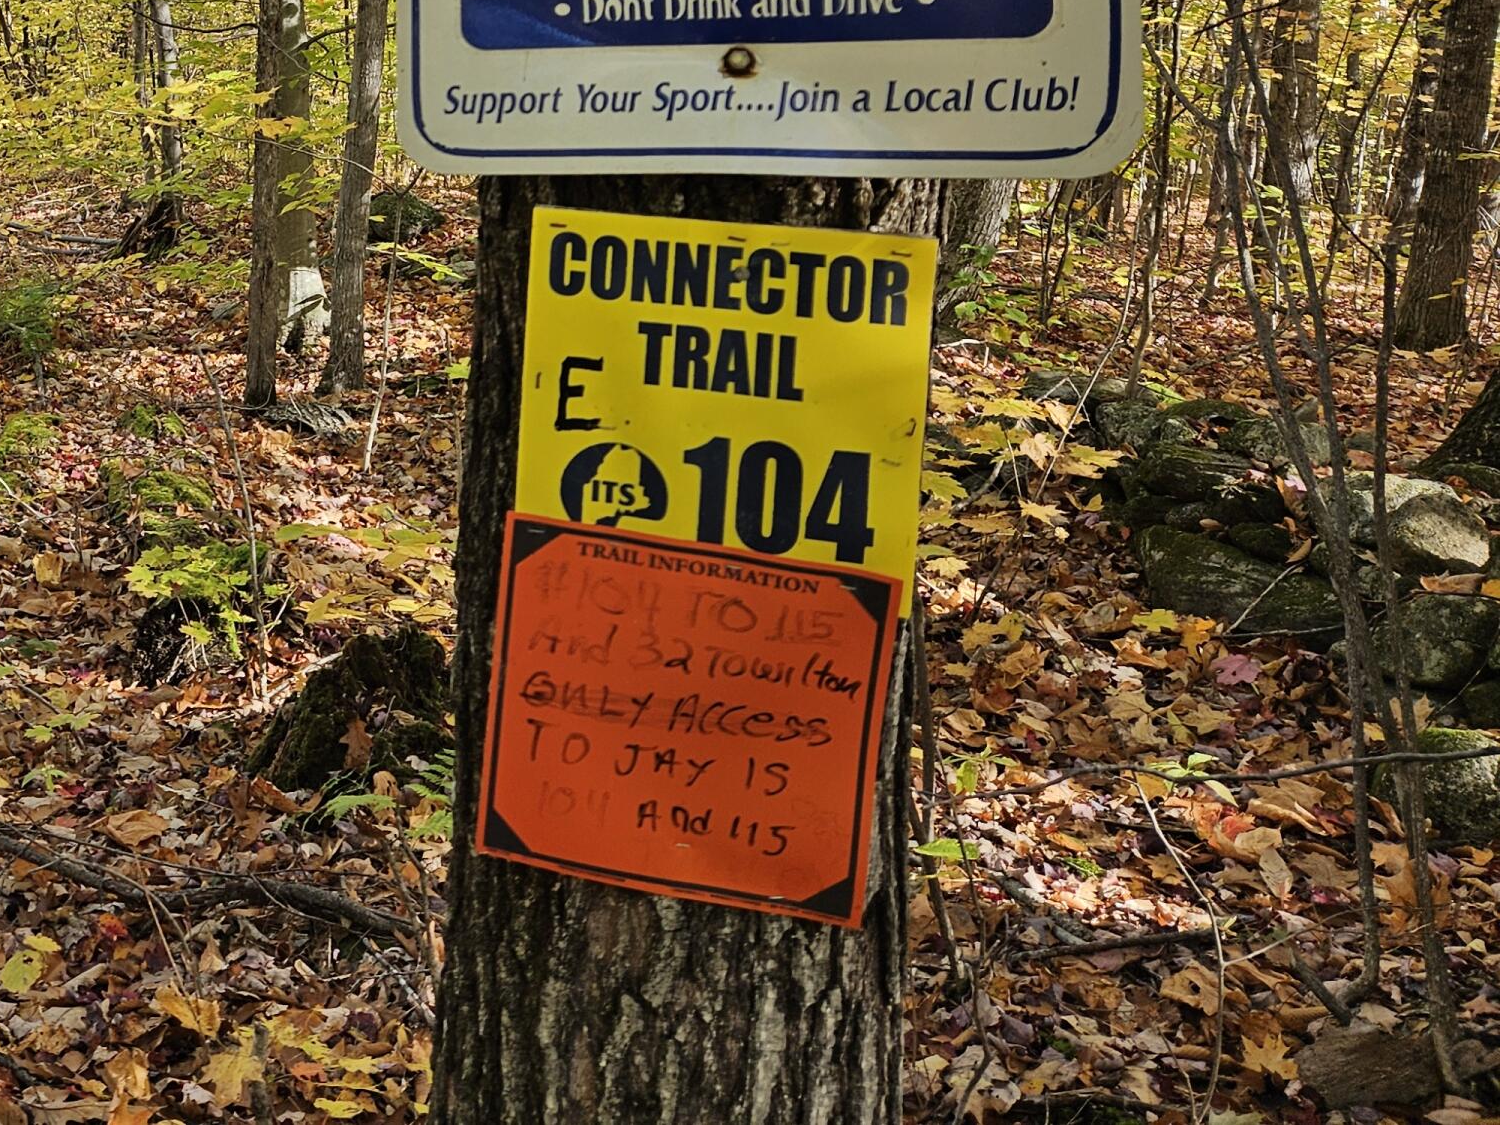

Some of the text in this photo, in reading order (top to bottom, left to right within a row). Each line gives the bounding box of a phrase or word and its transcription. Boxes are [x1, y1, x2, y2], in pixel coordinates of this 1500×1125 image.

[443, 85, 563, 124] Support
[575, 82, 642, 115] Your
[851, 89, 871, 112] a
[885, 80, 973, 112] Local
[984, 77, 1081, 112] Club!
[549, 232, 910, 326] CONNECTOR
[554, 356, 604, 431] E
[638, 321, 804, 402] TRAIL
[591, 436, 875, 565] ITS 104
[577, 541, 821, 594] TRAIL INFORMATION
[689, 586, 758, 632] TO
[765, 603, 844, 643] 115
[526, 718, 591, 765] TO
[614, 743, 716, 787] JAY
[730, 816, 795, 856] 115
